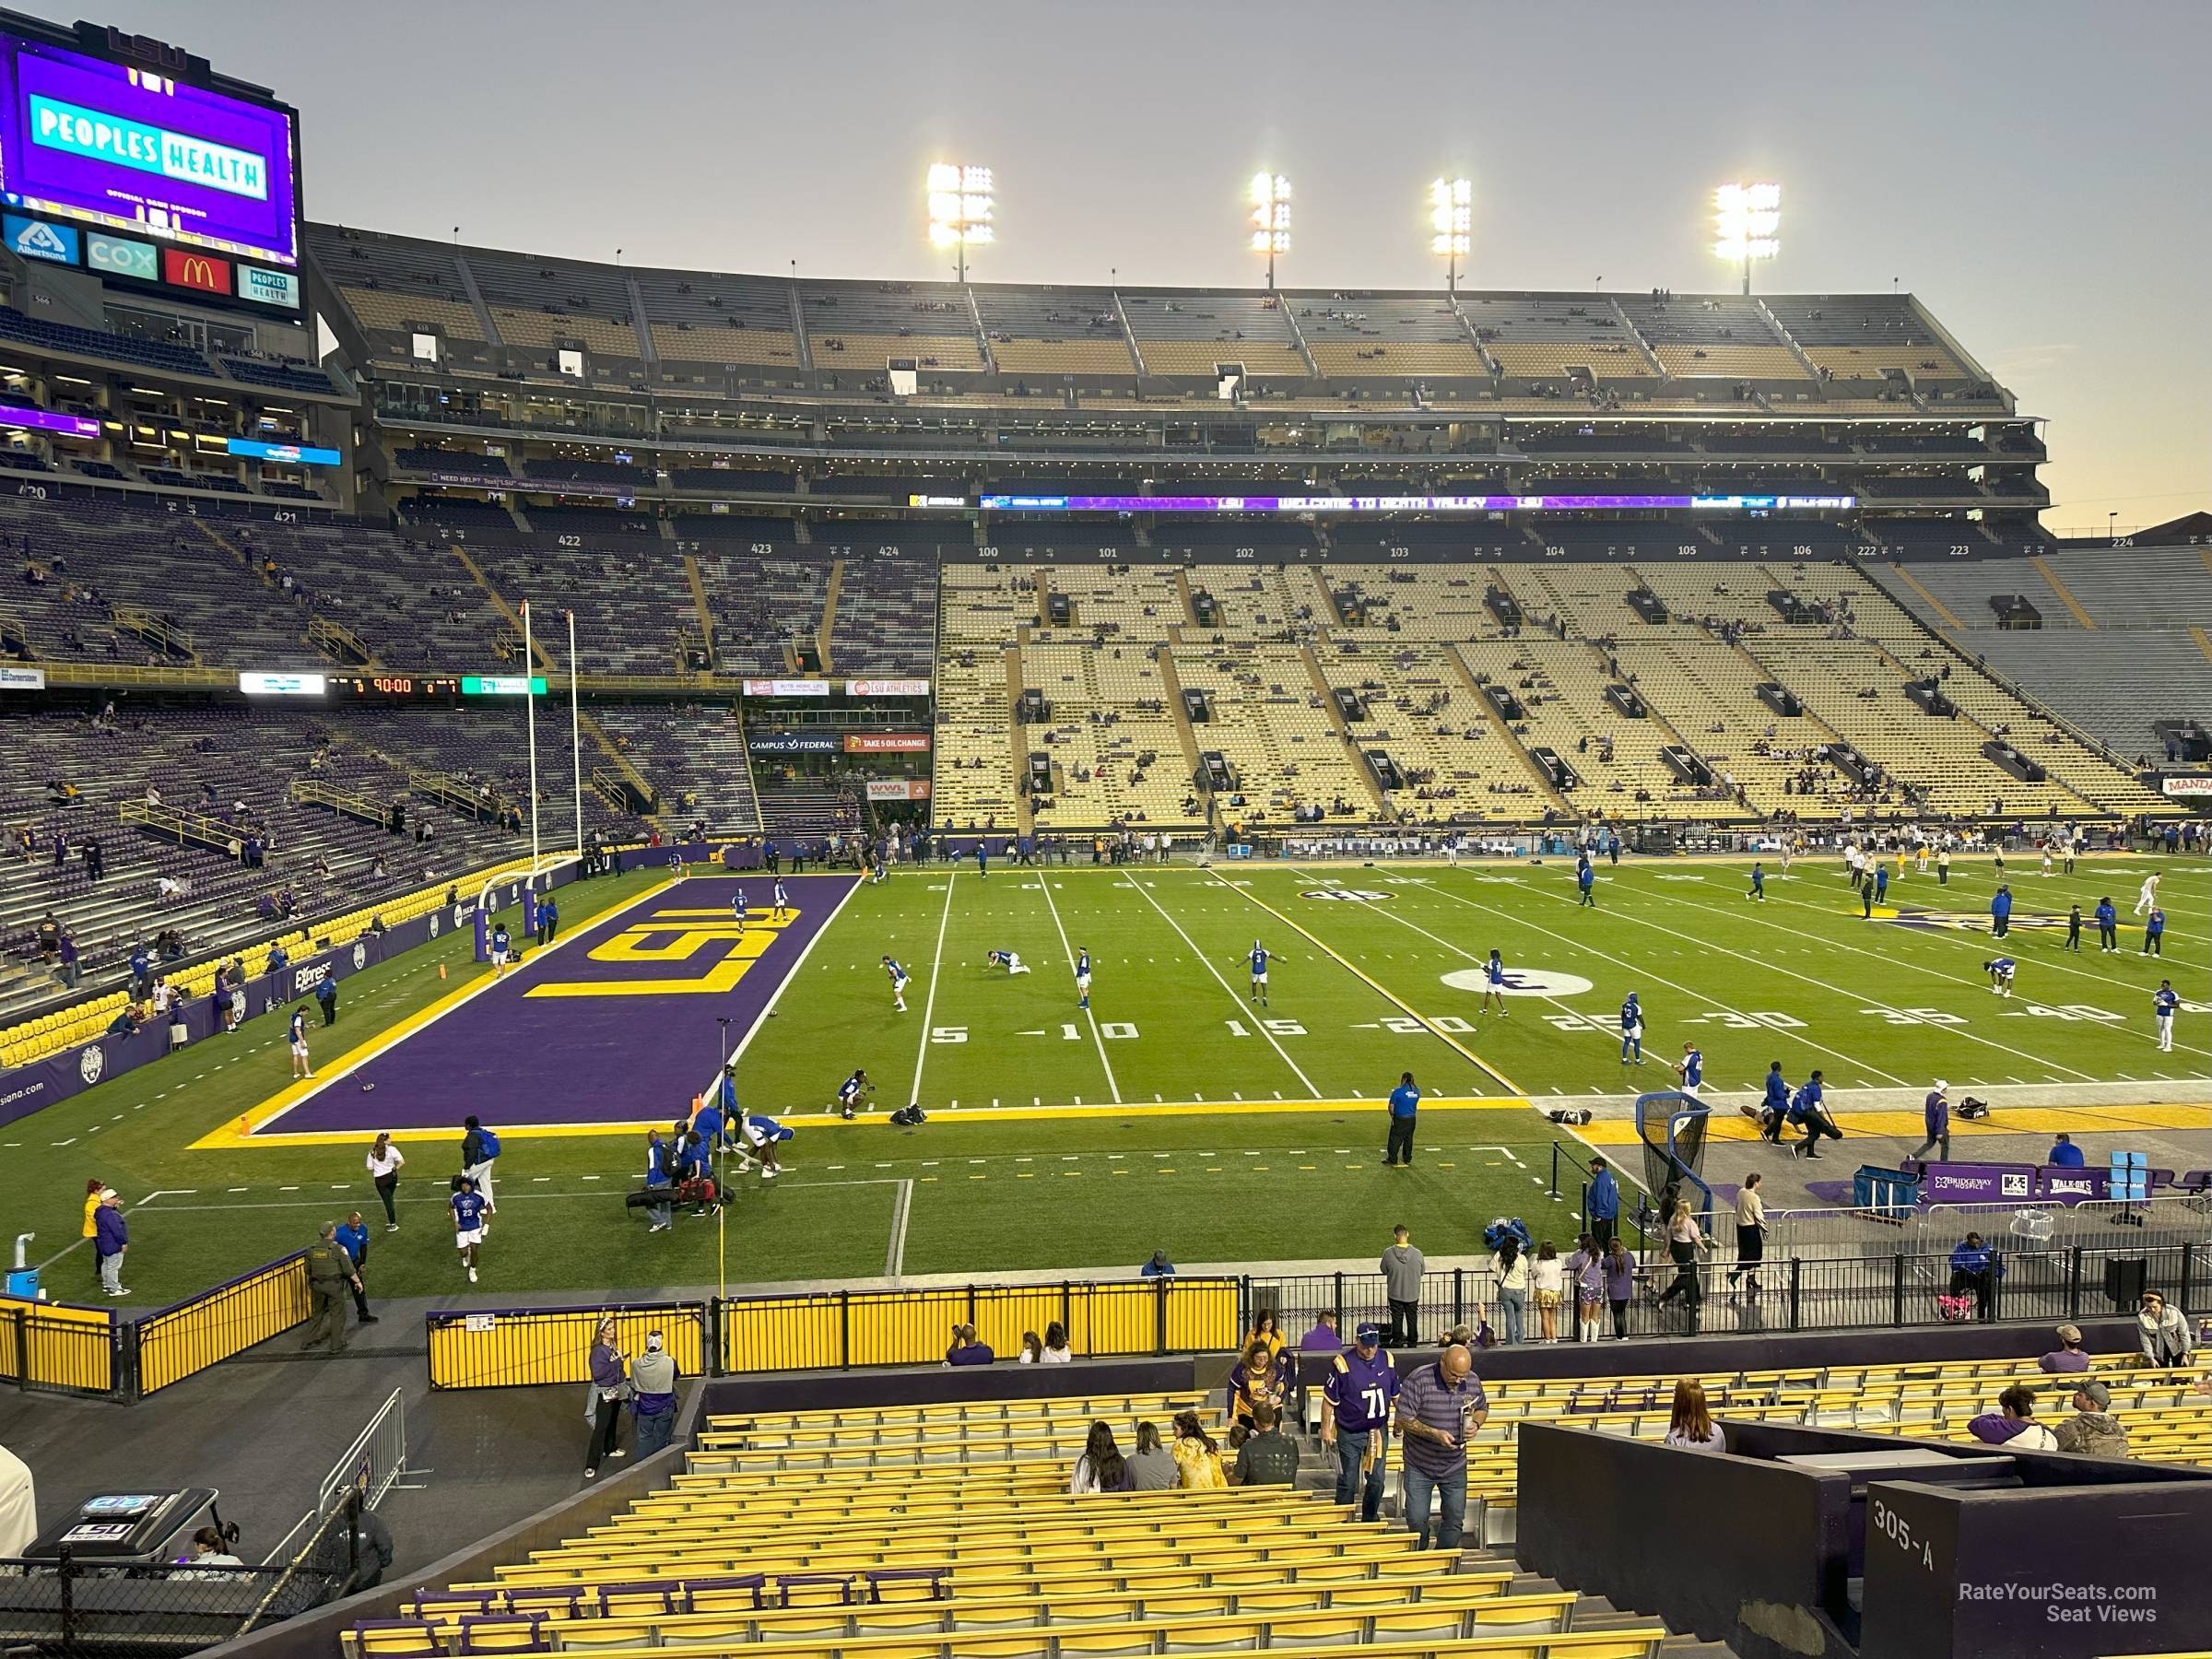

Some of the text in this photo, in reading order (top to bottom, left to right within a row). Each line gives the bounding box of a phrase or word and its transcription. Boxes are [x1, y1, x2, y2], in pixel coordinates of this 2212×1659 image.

[107, 26, 187, 71] LSU
[40, 107, 258, 187] PEOPLES HEALTH
[17, 243, 66, 261] Albertsons
[90, 241, 156, 273] COX
[251, 272, 287, 288] PEOPLES
[252, 287, 287, 300] HEALTH
[1278, 498, 1486, 508] WELCOME TO DEATH VALLEY
[274, 512, 297, 524] 421
[559, 535, 582, 547] 422
[2112, 538, 2134, 548] 224
[751, 544, 772, 554] 423
[879, 547, 900, 557] 424
[979, 547, 998, 558] 100
[1099, 547, 1117, 558] 101
[1236, 547, 1254, 558] 102
[1390, 547, 1409, 558] 103
[1546, 547, 1565, 557] 104
[1678, 546, 1697, 556] 105
[1793, 546, 1812, 556] 106
[1857, 546, 1877, 556] 222
[1950, 546, 1970, 555] 223
[374, 678, 411, 692] 90:00
[871, 684, 923, 693] LSU ATHLETICS
[799, 741, 833, 749] FEDERAL
[863, 739, 880, 747] TAKE
[886, 739, 897, 747] OIL
[897, 738, 926, 747] CHANGE
[522, 907, 801, 998] LSU
[1857, 1008, 1971, 1024] 35
[2025, 1005, 2128, 1020] 40
[1380, 1017, 1477, 1033] 20
[1702, 1012, 1809, 1028] 30
[1060, 1022, 1139, 1040] 10
[1225, 1019, 1309, 1038] 15
[931, 1027, 969, 1043] 5
[0, 1082, 44, 1106] siana.com
[1947, 1175, 1993, 1187] BRIDGEWAY
[2004, 1175, 2026, 1189] H&E
[2051, 1178, 2093, 1191] WALK-ON'S
[463, 1209, 473, 1218] 23
[1326, 1372, 1335, 1389] 71
[1361, 1388, 1386, 1419] 71
[69, 1524, 132, 1535] LSU
[1874, 1499, 1934, 1571] 305-A
